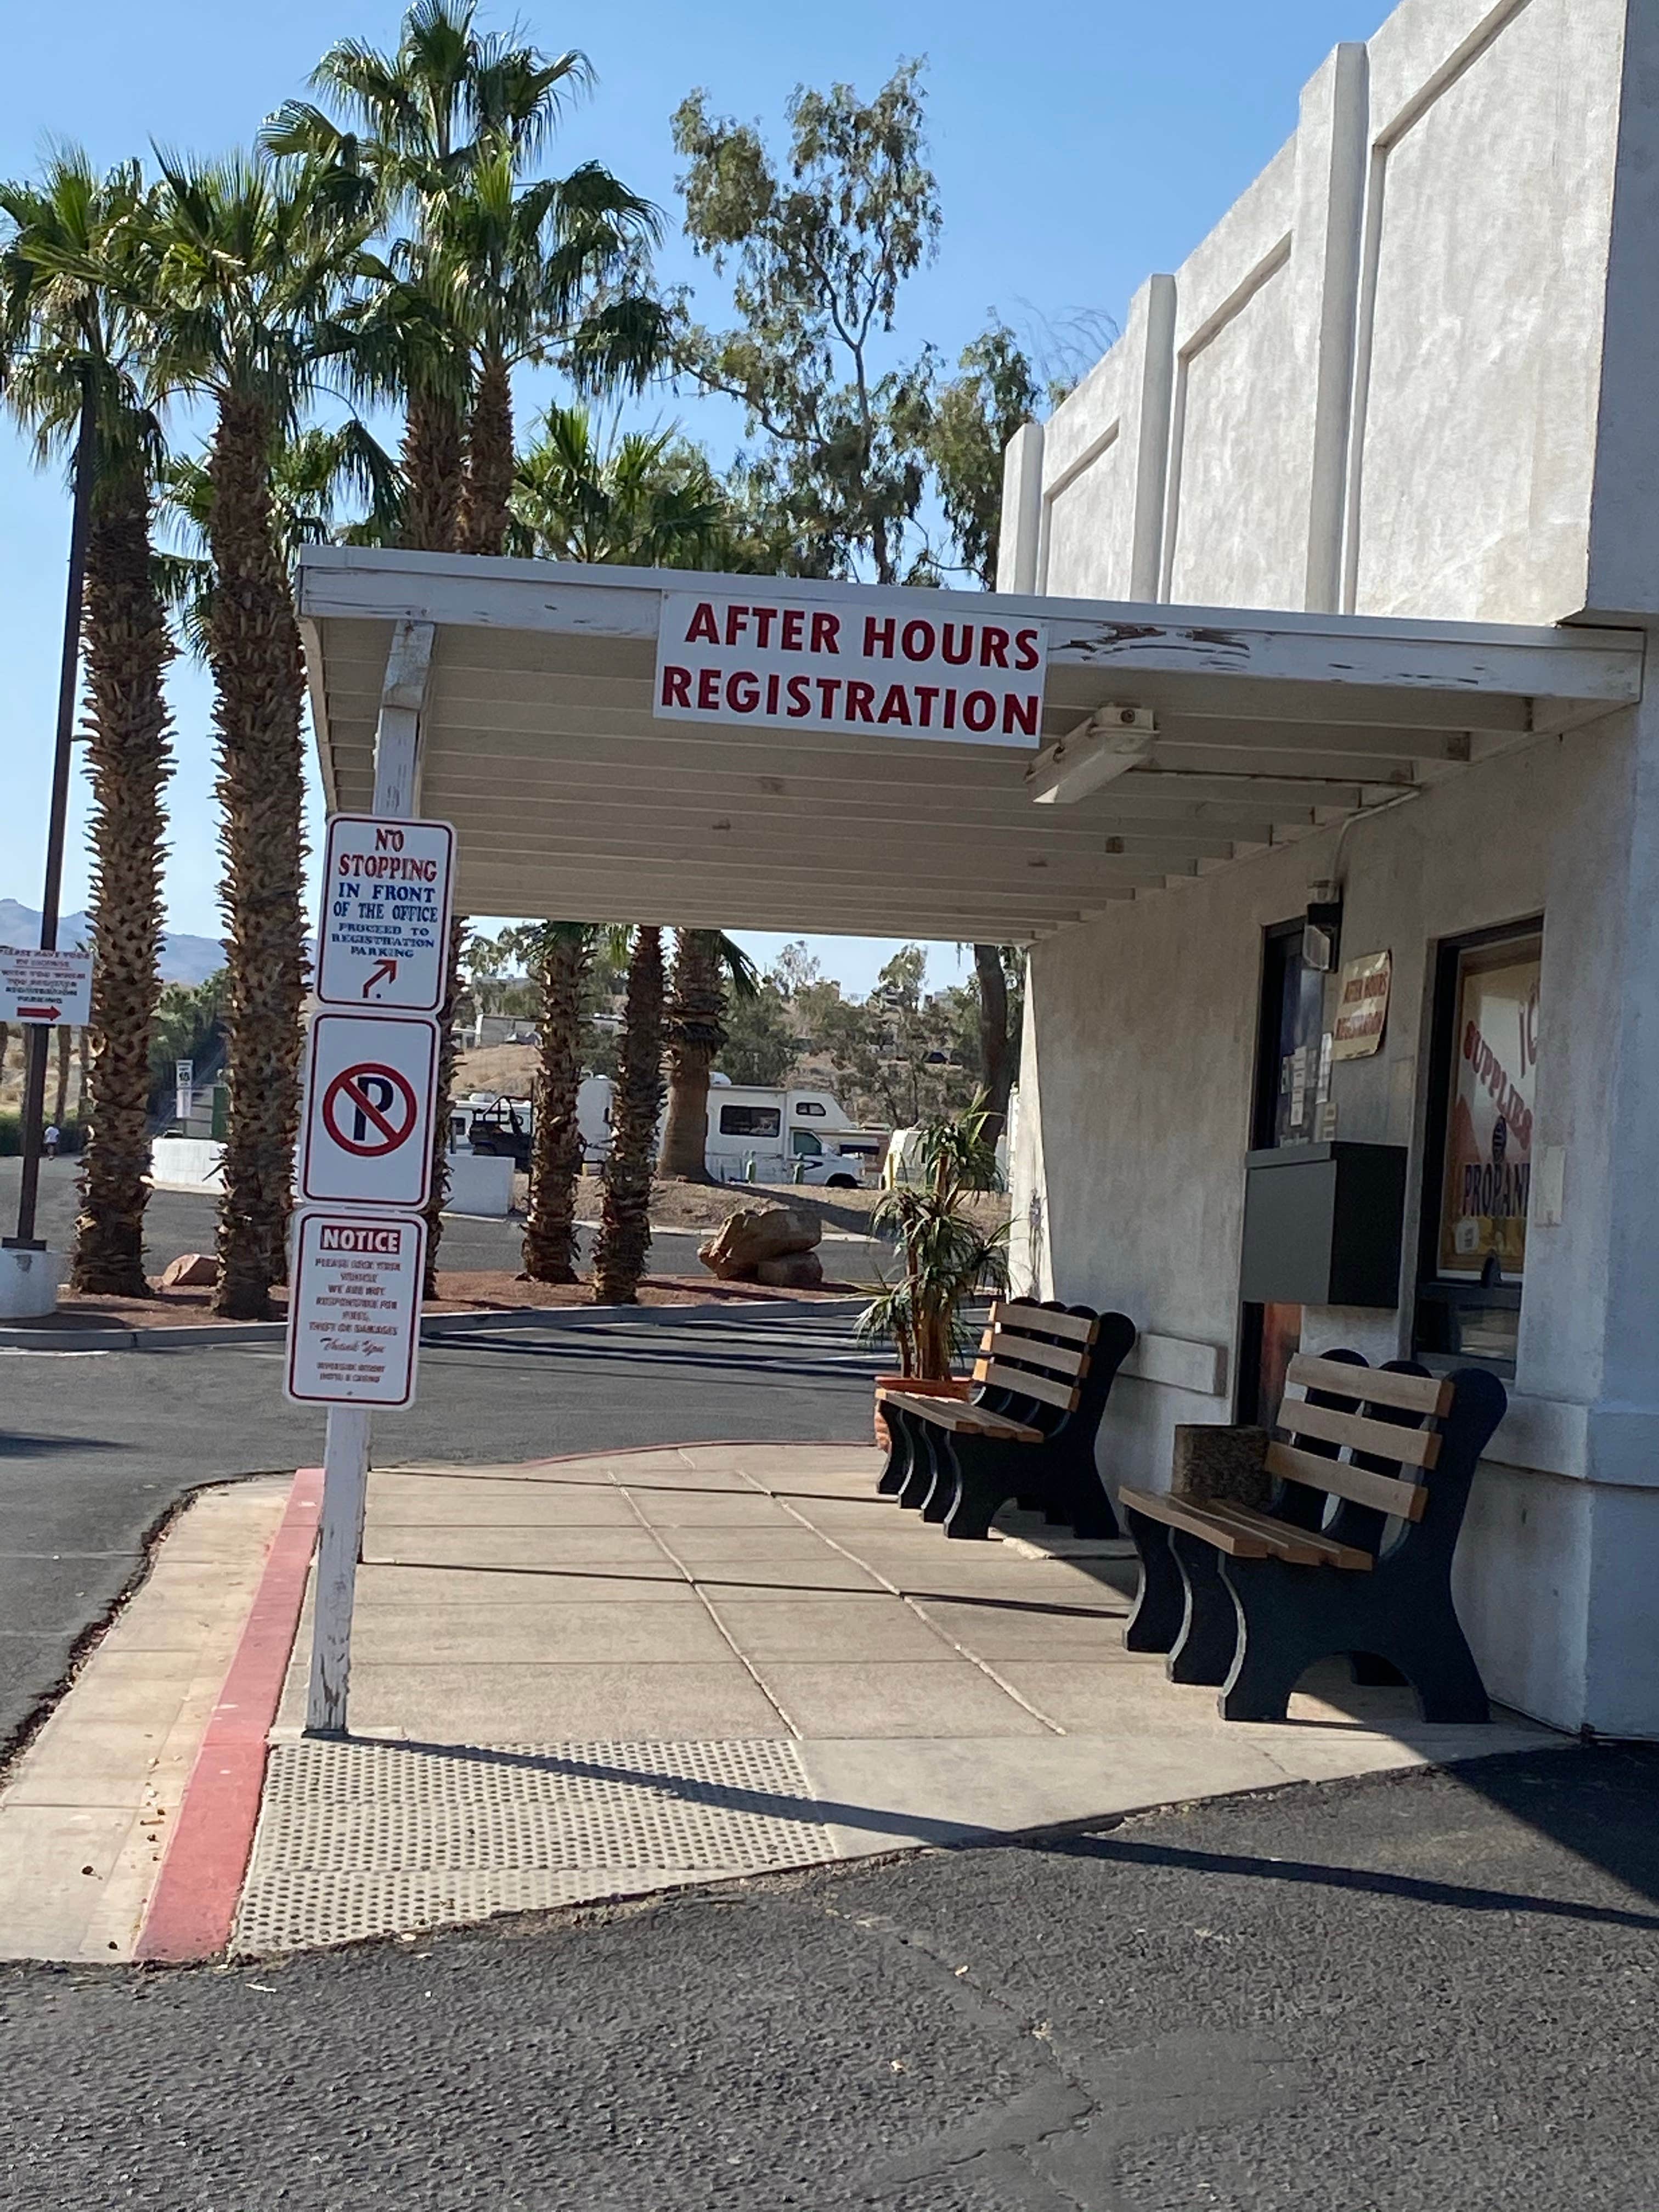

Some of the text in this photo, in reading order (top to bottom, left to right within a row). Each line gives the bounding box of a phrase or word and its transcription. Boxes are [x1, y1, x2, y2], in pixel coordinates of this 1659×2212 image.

[684, 602, 1039, 671] AFTER HOURS
[661, 665, 1039, 736] REGISTRATION
[375, 828, 404, 852] NO
[338, 853, 437, 882] STOPPING
[338, 882, 436, 903] IN FRONT
[333, 901, 438, 923] OF THE OFFICE
[331, 933, 435, 948] REGISTRATION
[338, 922, 430, 936] PROCEED TO
[351, 945, 414, 958] PARKING
[323, 1229, 398, 1253] NOTICE
